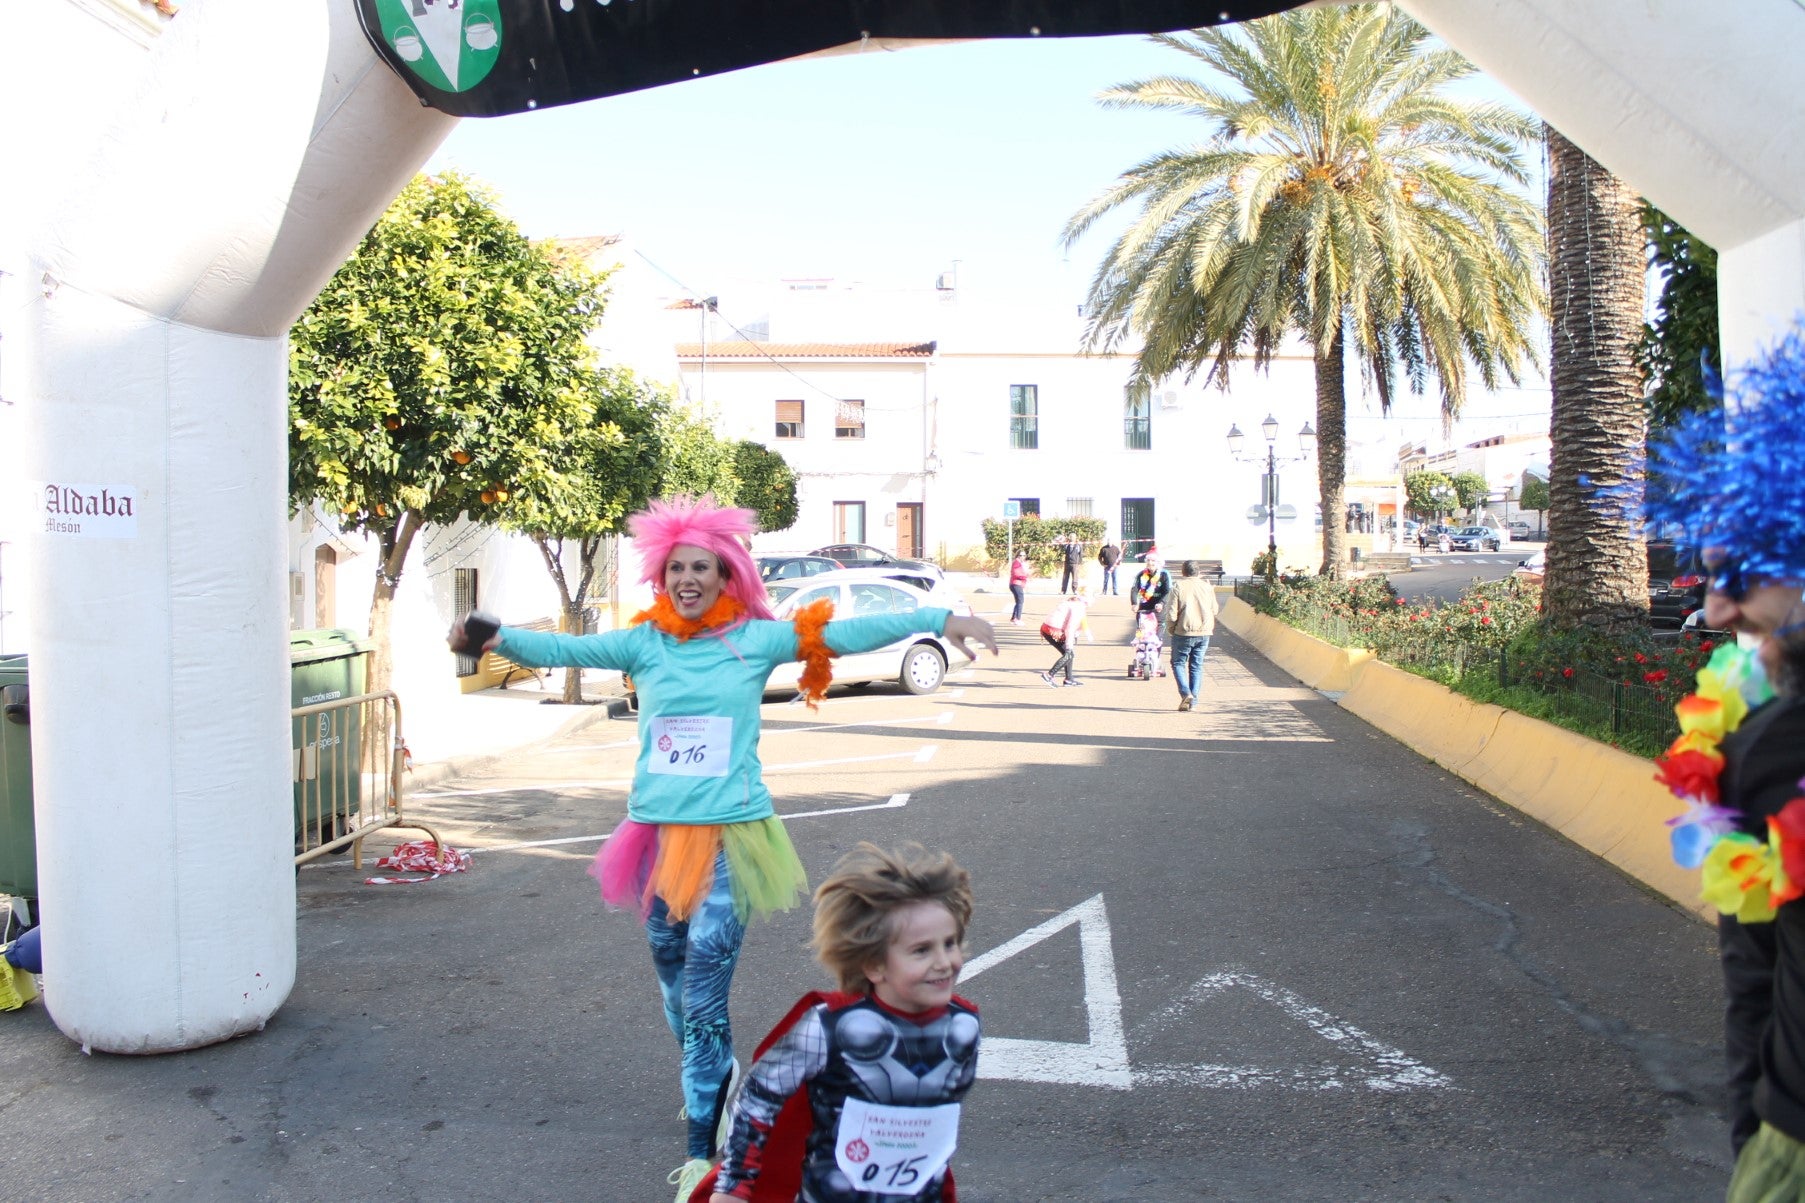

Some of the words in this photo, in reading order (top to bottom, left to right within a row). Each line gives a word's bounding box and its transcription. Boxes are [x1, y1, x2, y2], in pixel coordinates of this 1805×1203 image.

[45, 484, 133, 517] Aldaba
[45, 517, 81, 534] Mesón
[303, 693, 326, 704] FRACCIÓN
[325, 691, 340, 699] RESTO
[669, 745, 706, 764] 016
[862, 1155, 928, 1186] 015
